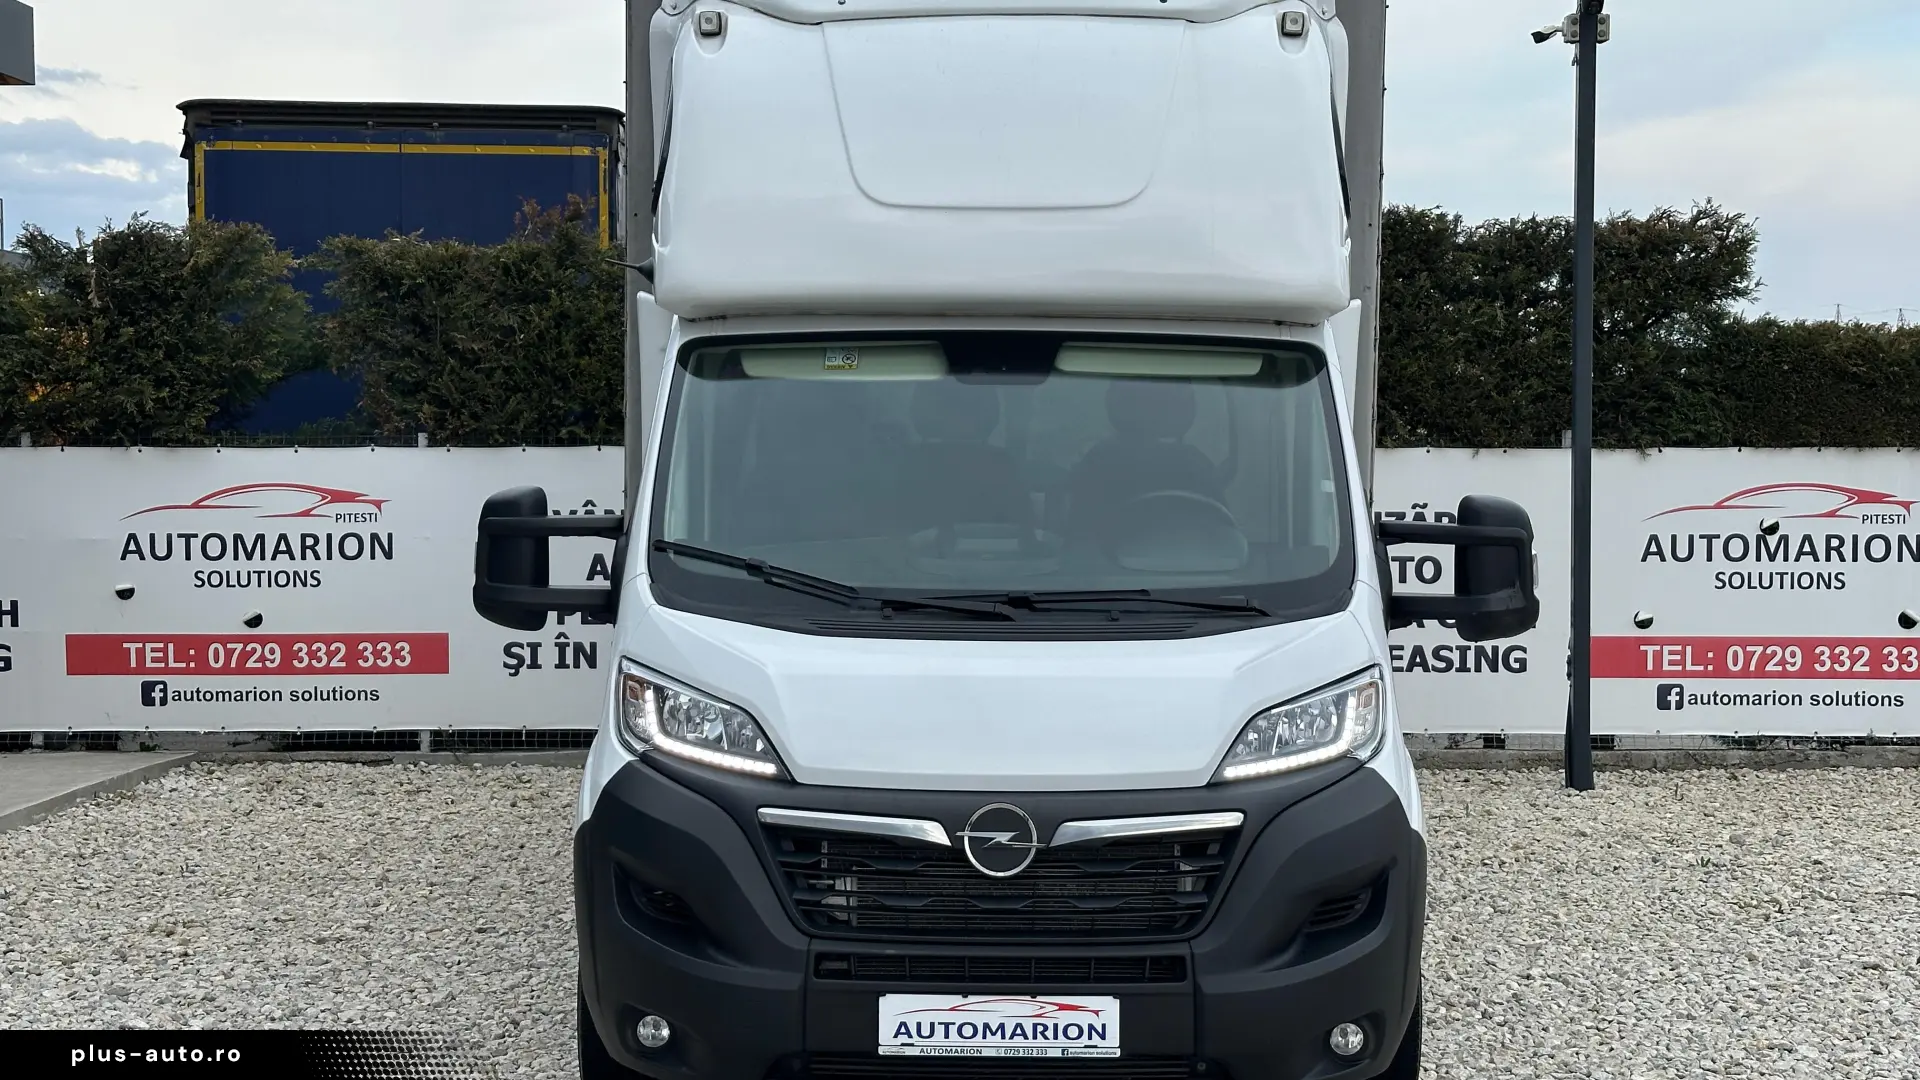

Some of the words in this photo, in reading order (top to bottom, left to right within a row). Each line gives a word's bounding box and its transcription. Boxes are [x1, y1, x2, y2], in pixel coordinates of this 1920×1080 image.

[335, 512, 378, 524] PITESTI
[1862, 513, 1906, 525] PITESTI
[120, 532, 394, 562] AUTOMARION
[1641, 532, 1920, 563] AUTOMARION
[193, 569, 322, 589] SOLUTIONS
[1714, 571, 1846, 591] SOLUTIONS
[123, 642, 196, 668] TEL:
[208, 642, 281, 668] 0729
[292, 641, 347, 667] 332
[357, 641, 412, 667] 333
[554, 632, 598, 669] ÎN
[1640, 645, 1714, 671] TEL:
[1726, 645, 1802, 672] 0729
[1813, 646, 1870, 672] 332
[171, 685, 283, 703] automarion
[289, 685, 380, 702] solutions
[1687, 689, 1803, 706] automarion
[1809, 689, 1905, 708] solutions
[893, 1021, 1107, 1041] AUTOMARION
[919, 1047, 983, 1055] AUTOMARION
[1003, 1048, 1021, 1056] 0729
[1021, 1048, 1034, 1056] 332
[1035, 1048, 1048, 1056] 333
